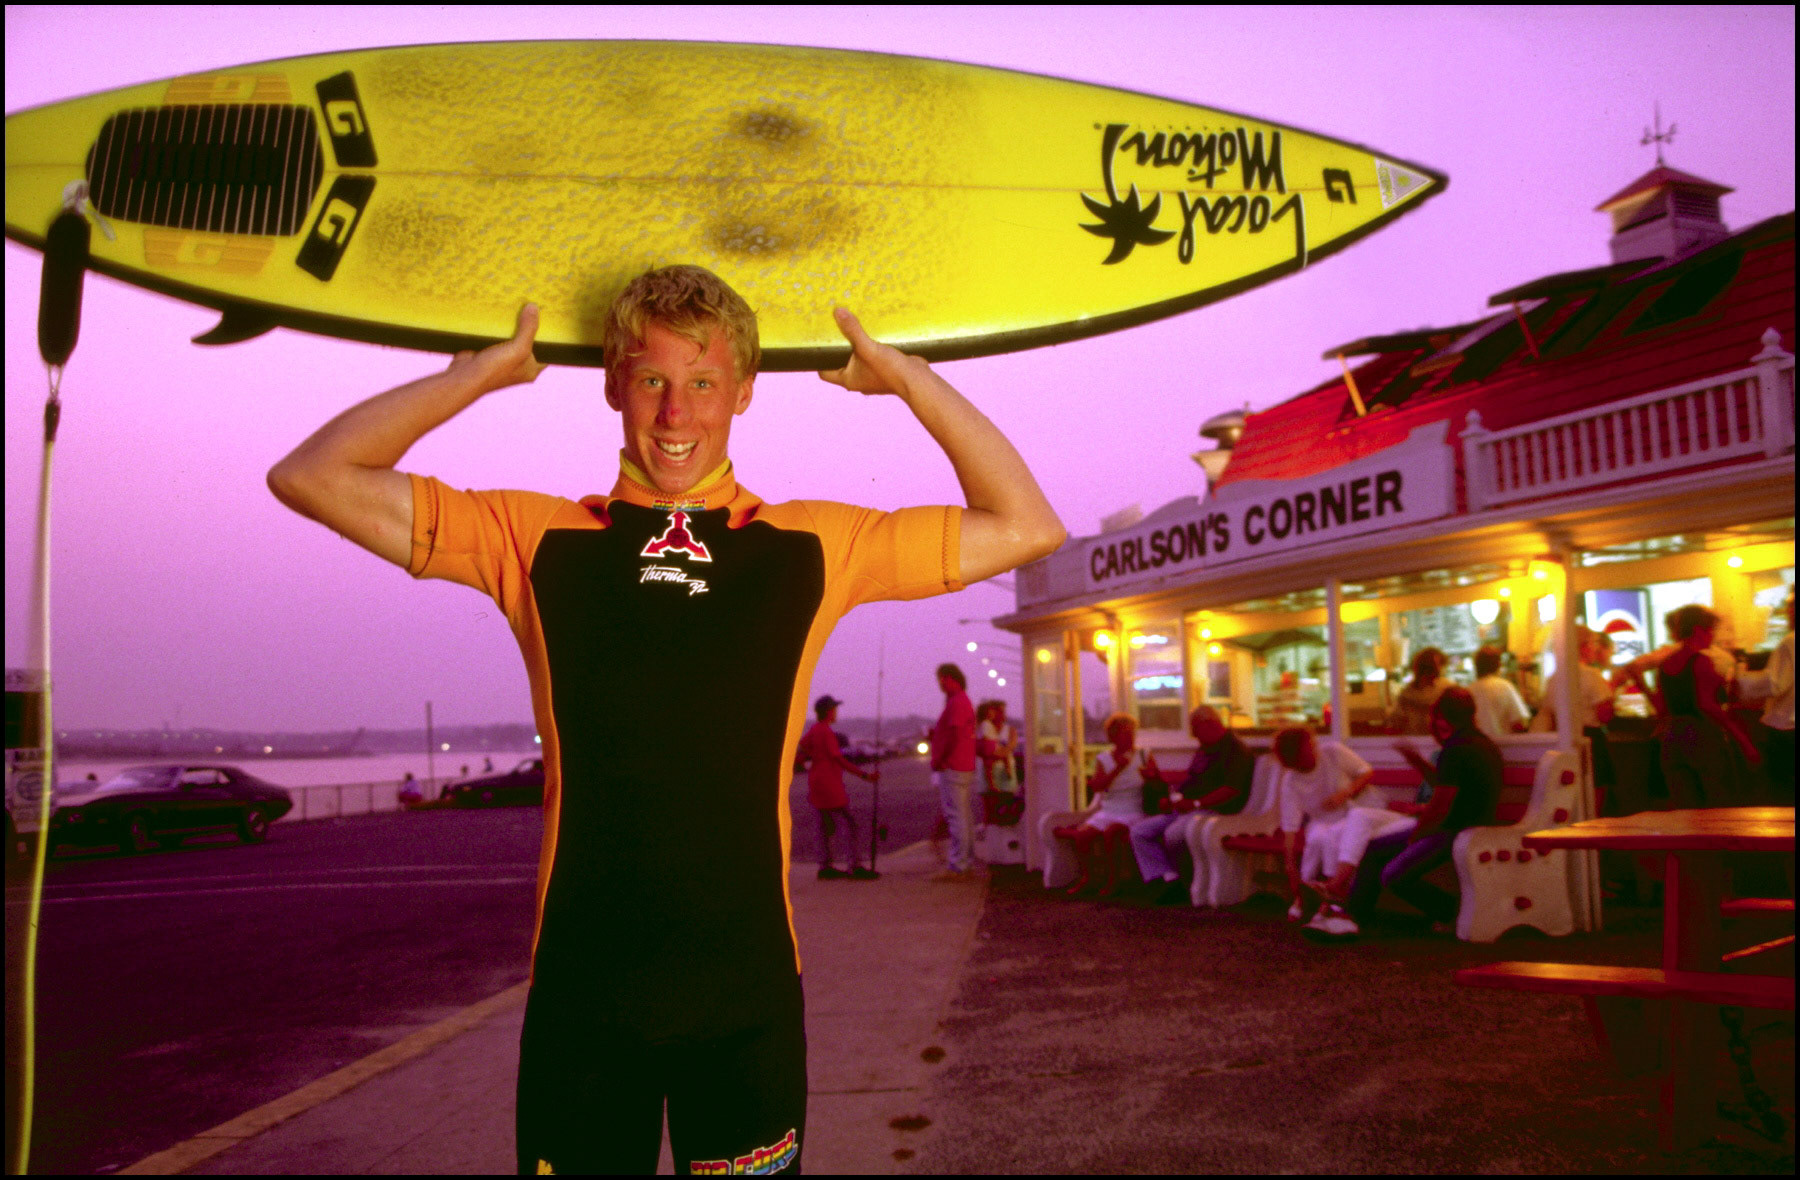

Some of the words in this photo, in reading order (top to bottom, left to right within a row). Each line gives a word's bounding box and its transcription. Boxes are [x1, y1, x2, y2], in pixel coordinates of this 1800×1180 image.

[325, 99, 365, 137] G
[1119, 127, 1286, 195] Motion
[317, 197, 358, 248] G
[1177, 191, 1307, 268] Local
[1090, 512, 1231, 583] CARLSON'S
[1243, 470, 1405, 546] CORNER
